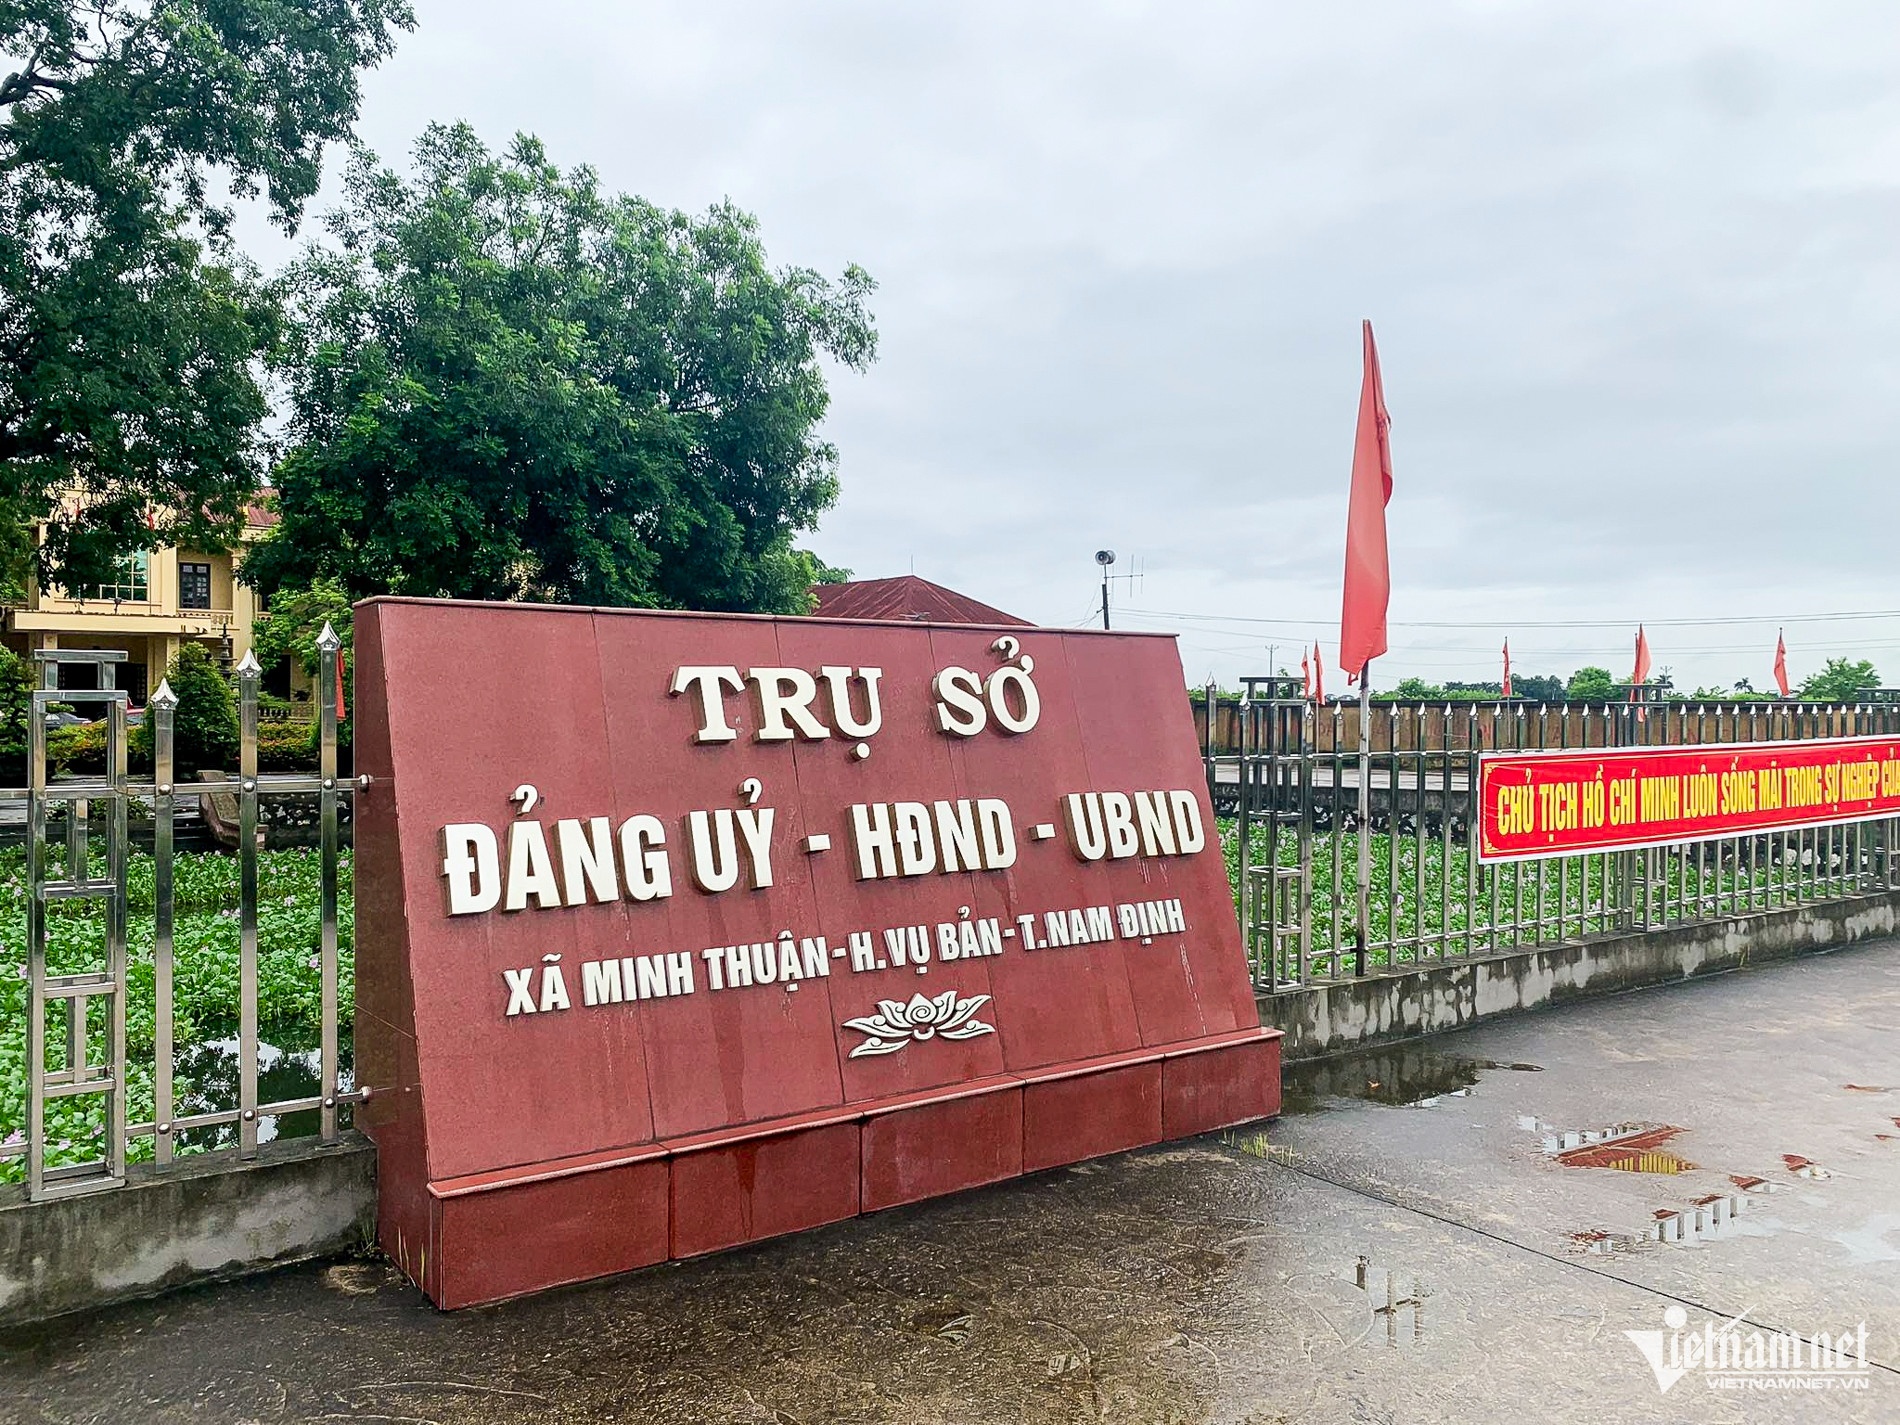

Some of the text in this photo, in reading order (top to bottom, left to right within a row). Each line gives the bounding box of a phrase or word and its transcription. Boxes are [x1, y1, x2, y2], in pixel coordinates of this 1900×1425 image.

[668, 634, 1041, 761] TRỤ SỞ
[440, 783, 674, 917] ĐẢNG
[686, 777, 776, 894] UỶ
[847, 798, 1018, 880] HĐND
[1062, 789, 1206, 862] UBND
[1497, 767, 1535, 836] CHỦ
[1539, 782, 1578, 842] TỊCH
[1582, 764, 1605, 829] HỒ
[1609, 767, 1637, 826] CHÍ
[1640, 775, 1680, 823] MINH
[1683, 764, 1718, 819] LUÔN
[1721, 756, 1756, 815] SỐNG
[1758, 760, 1782, 811] MÃI
[1784, 764, 1823, 808] TRONG
[1825, 759, 1841, 812] SỰ
[1841, 752, 1880, 808] NGHIỆP
[502, 953, 572, 1017] XÃ
[581, 951, 695, 1007] MINH
[1116, 898, 1187, 945] ĐỊNH
